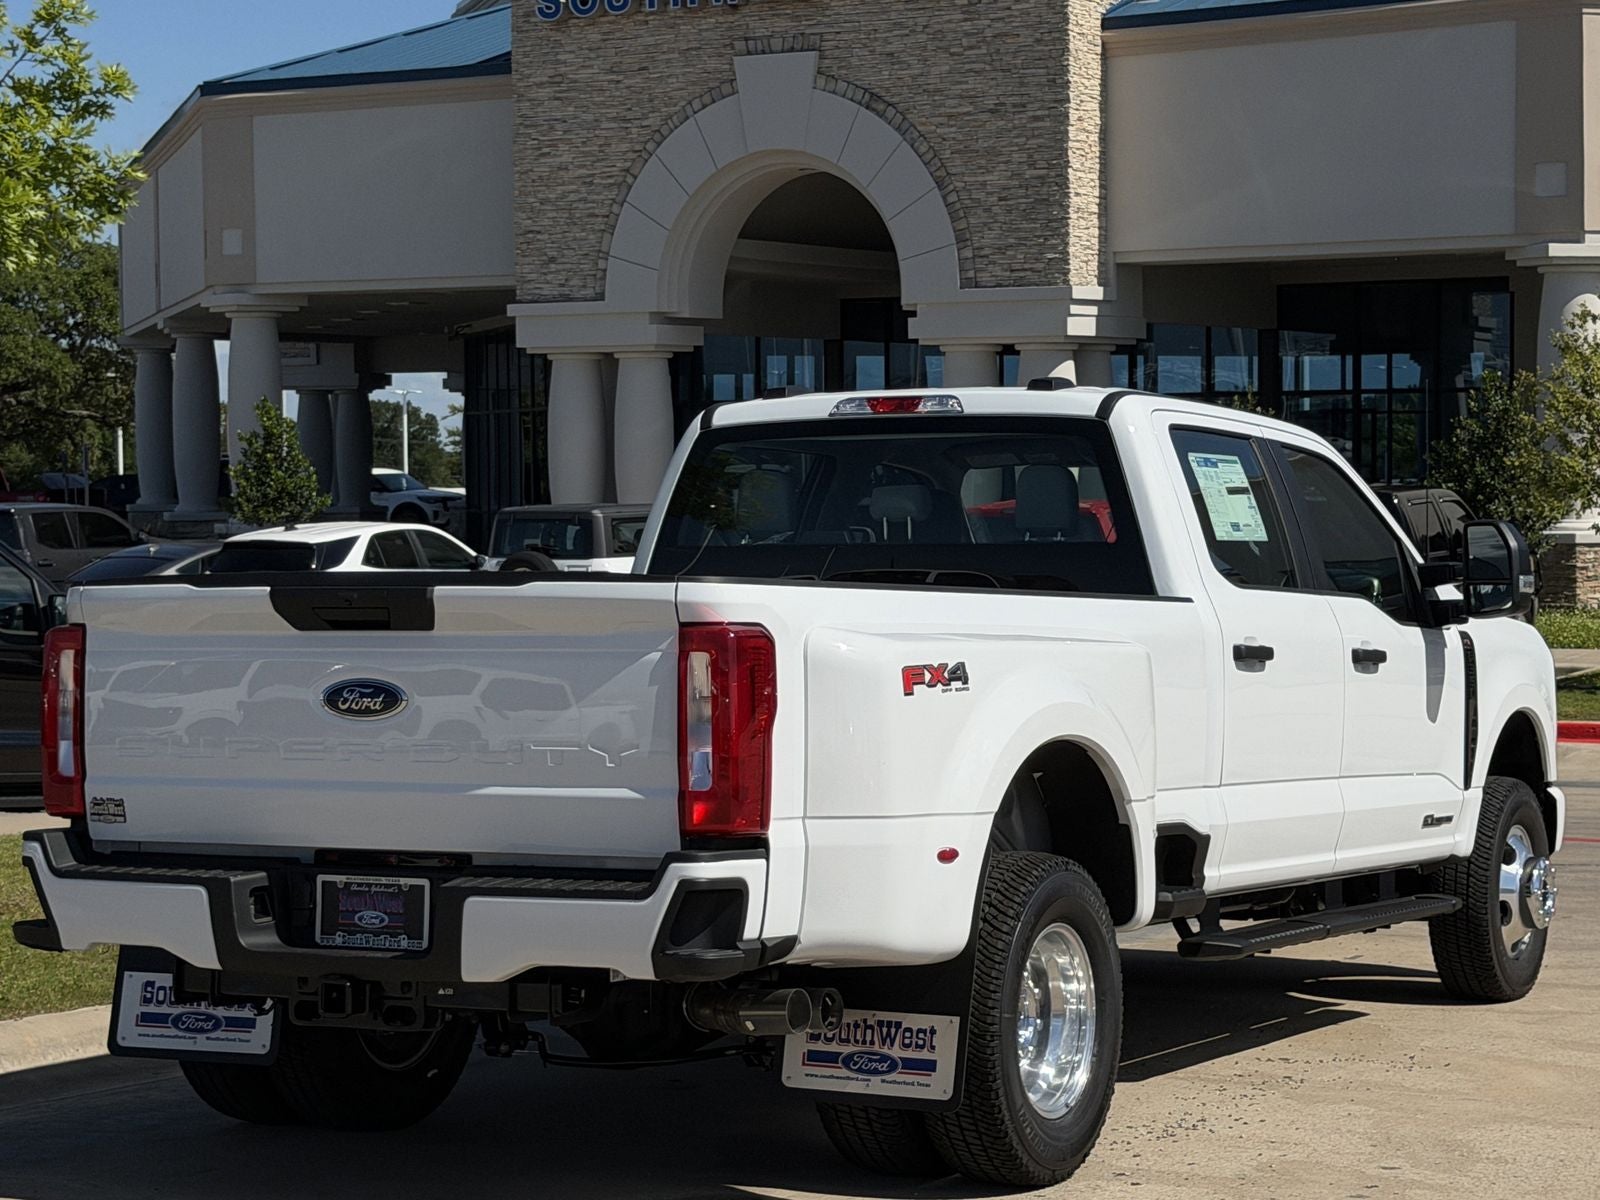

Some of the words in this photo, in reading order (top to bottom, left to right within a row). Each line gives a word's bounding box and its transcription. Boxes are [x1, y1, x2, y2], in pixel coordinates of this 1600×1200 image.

[901, 661, 969, 697] FX4
[338, 687, 386, 710] Ford
[410, 739, 640, 767] DUTY
[361, 913, 382, 925] Ford
[178, 1013, 216, 1031] Ford
[849, 1052, 890, 1072] Ford
